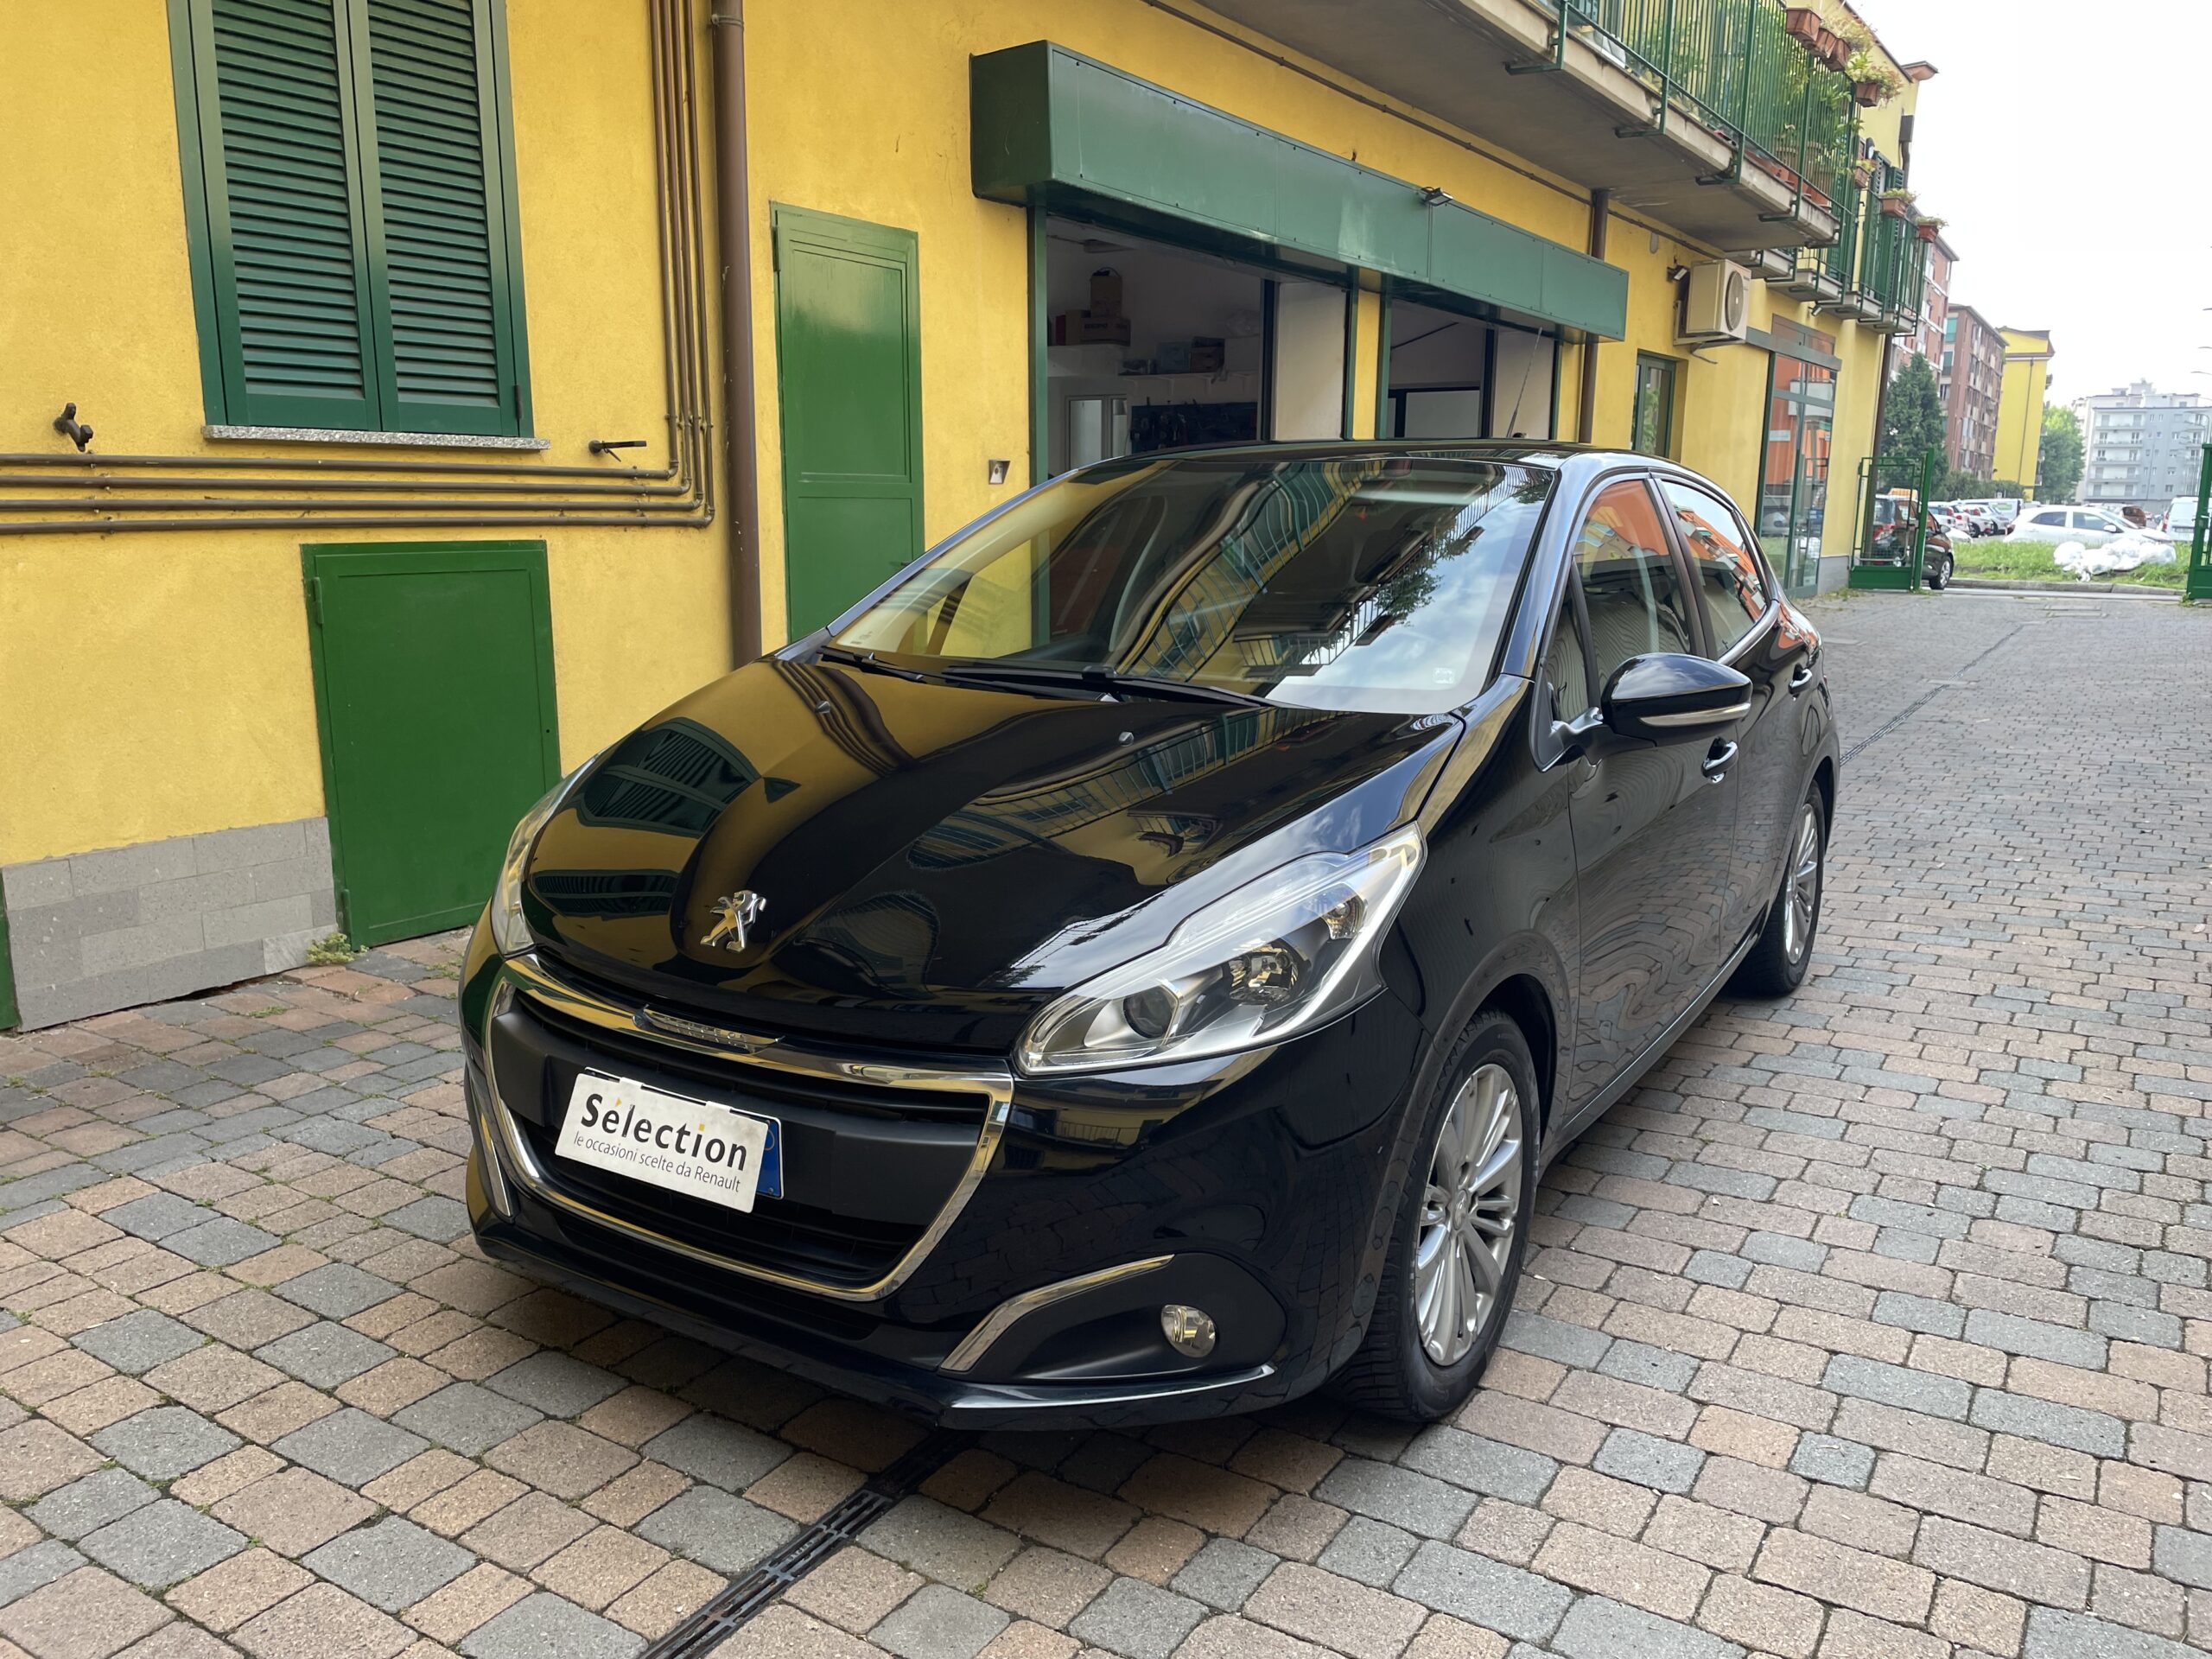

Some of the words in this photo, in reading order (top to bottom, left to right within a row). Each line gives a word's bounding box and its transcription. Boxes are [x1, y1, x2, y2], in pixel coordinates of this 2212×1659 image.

[574, 1130, 585, 1147] le
[585, 1136, 638, 1162] occasioni
[639, 1154, 674, 1173] scelte
[676, 1161, 691, 1178] da
[694, 1166, 741, 1193] Renault
